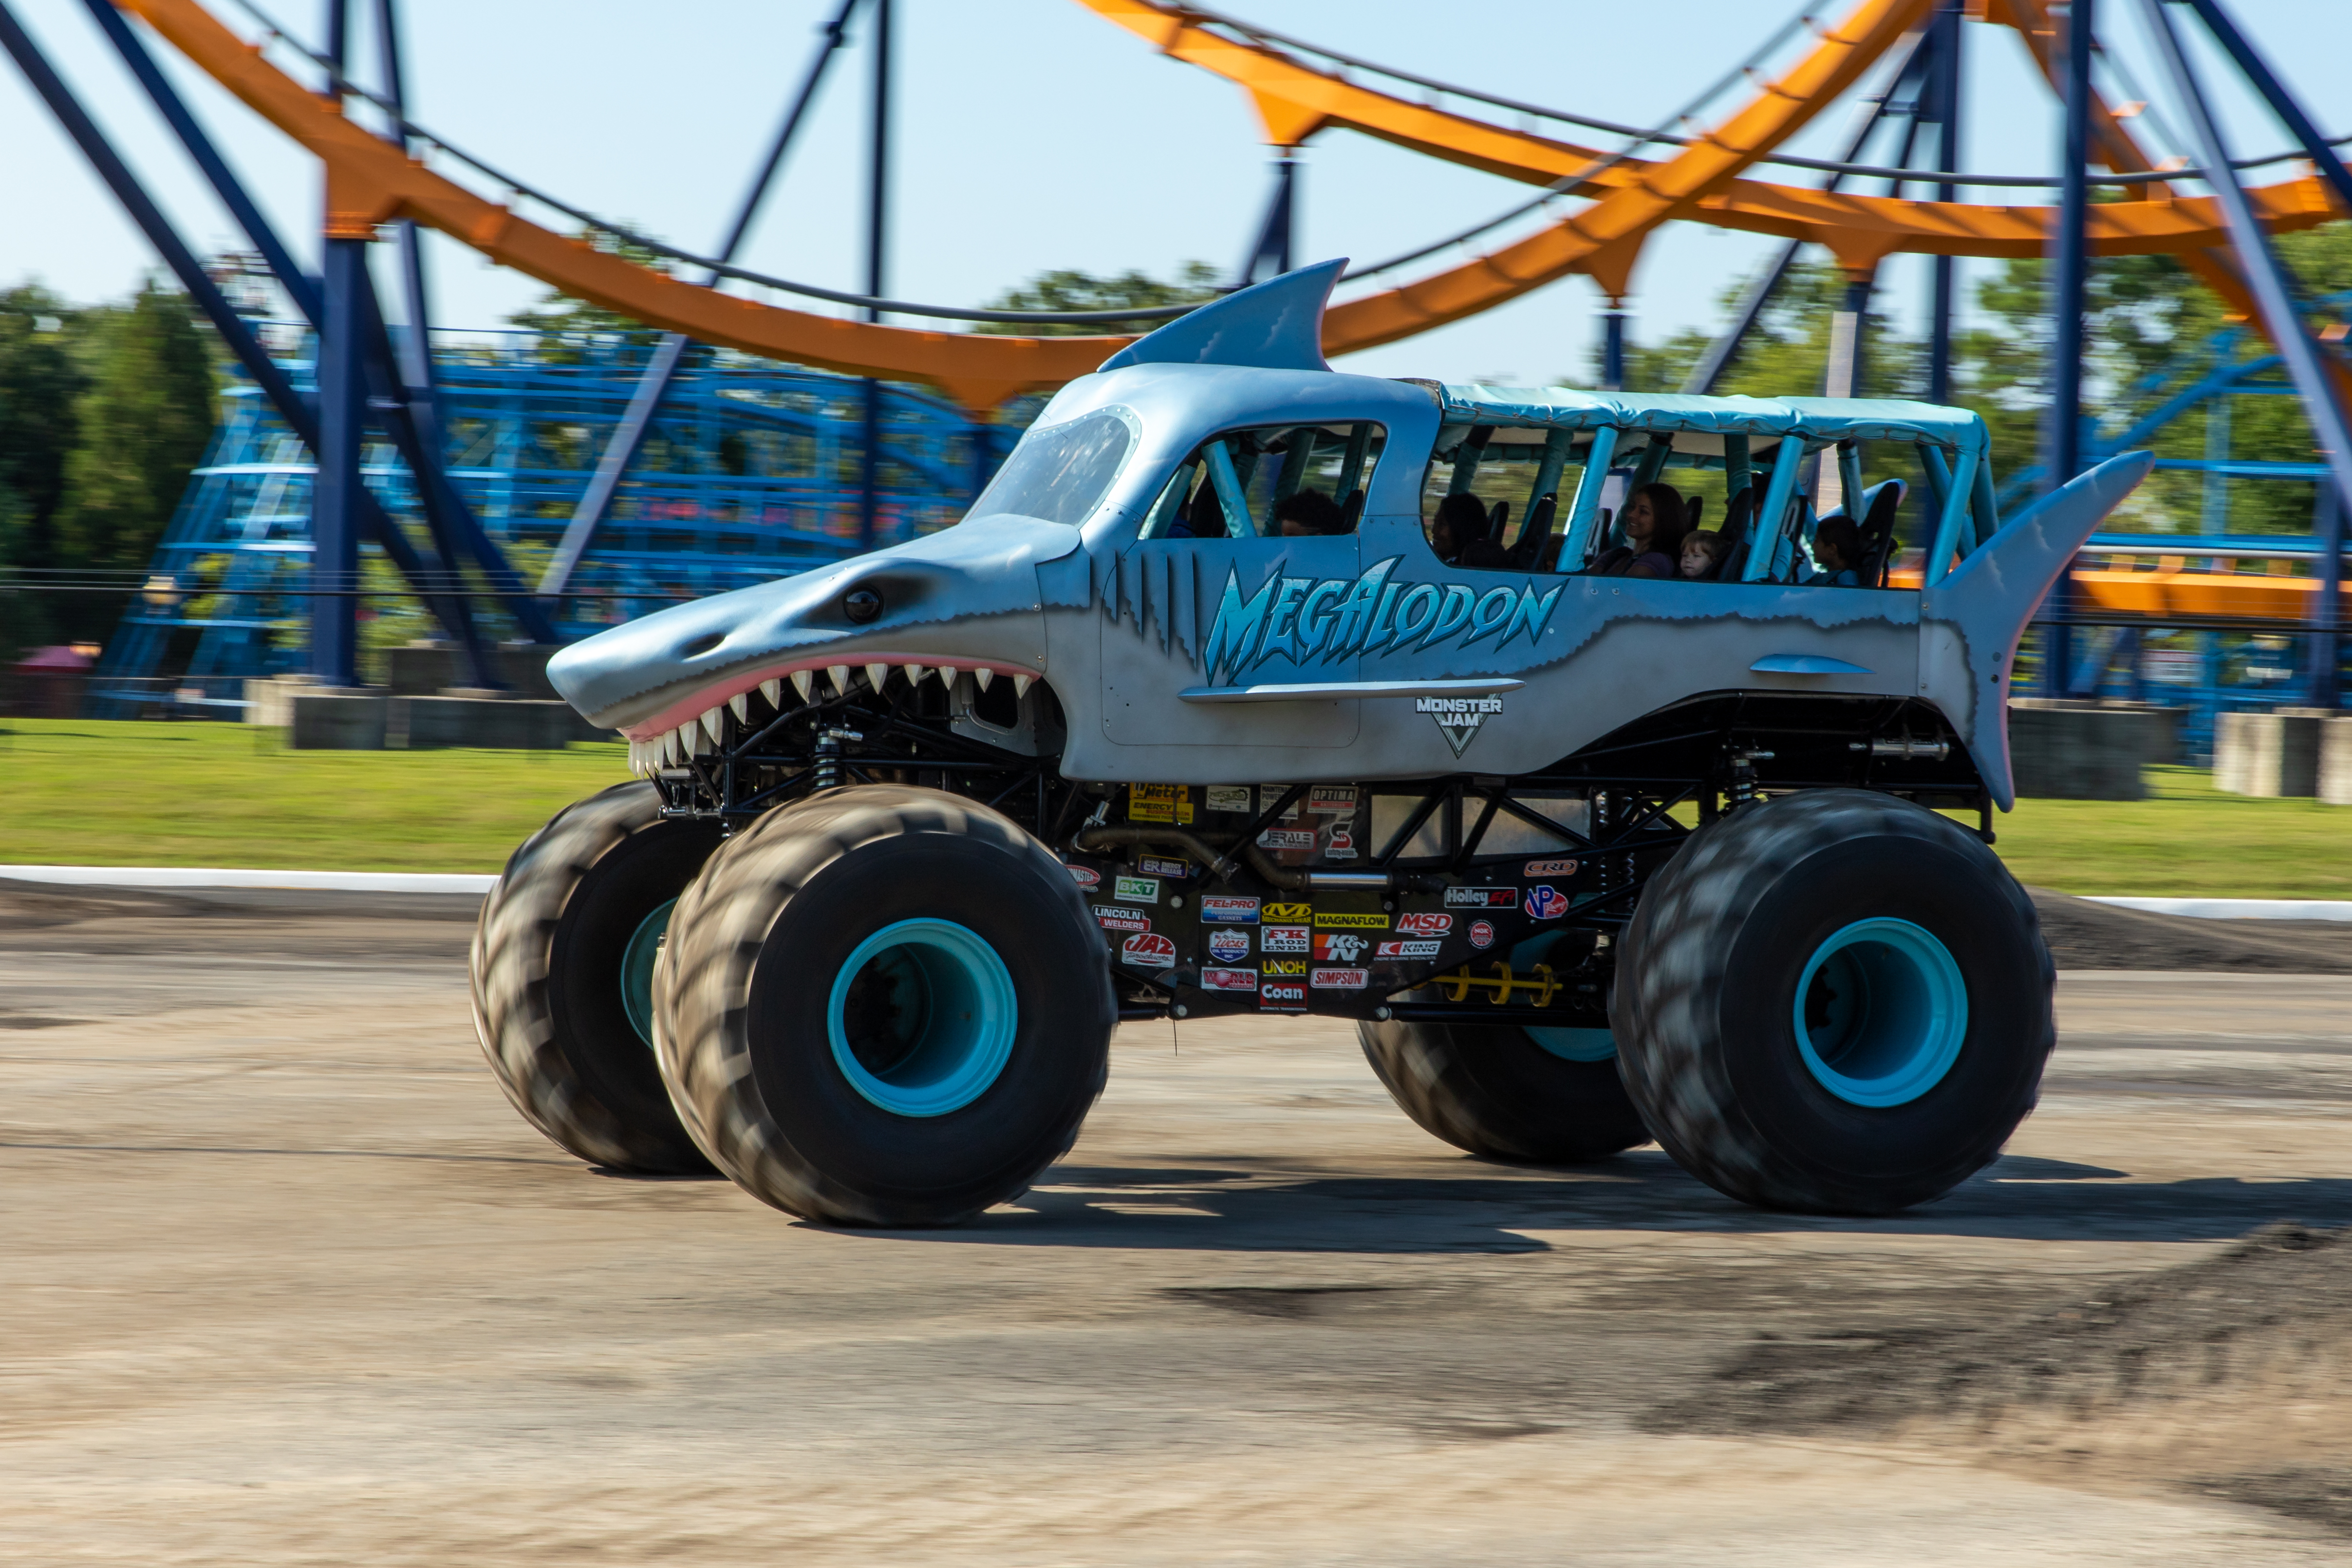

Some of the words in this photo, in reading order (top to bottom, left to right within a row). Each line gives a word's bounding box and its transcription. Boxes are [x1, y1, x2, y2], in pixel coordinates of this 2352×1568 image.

[1203, 554, 1570, 687] MEGALODON
[1417, 699, 1502, 712] MONSTER
[1441, 713, 1479, 726] JAM
[1313, 790, 1353, 801] OPTIMA
[1134, 802, 1173, 810] ENERGY
[1143, 859, 1161, 873] ER
[1161, 861, 1182, 869] ENERGY
[1528, 862, 1575, 872] CRD
[1119, 881, 1155, 894] BKT
[1204, 899, 1256, 909] FEL-PRO
[1446, 889, 1489, 907] Holley
[1528, 885, 1555, 918] VP
[1095, 907, 1141, 920] LINCOLN
[1104, 919, 1144, 930] WELDERS
[1317, 916, 1386, 925] MAGNAFLOW
[1397, 914, 1453, 931] MSD
[1269, 930, 1306, 939] FK
[1124, 934, 1174, 955] JAZ
[1214, 938, 1246, 948] LUCAS
[1402, 943, 1438, 952] KING
[1263, 959, 1307, 974] UNOH
[1204, 969, 1255, 987] WORLD
[1315, 971, 1363, 985] SIMPSON
[1261, 984, 1303, 999] Coan
